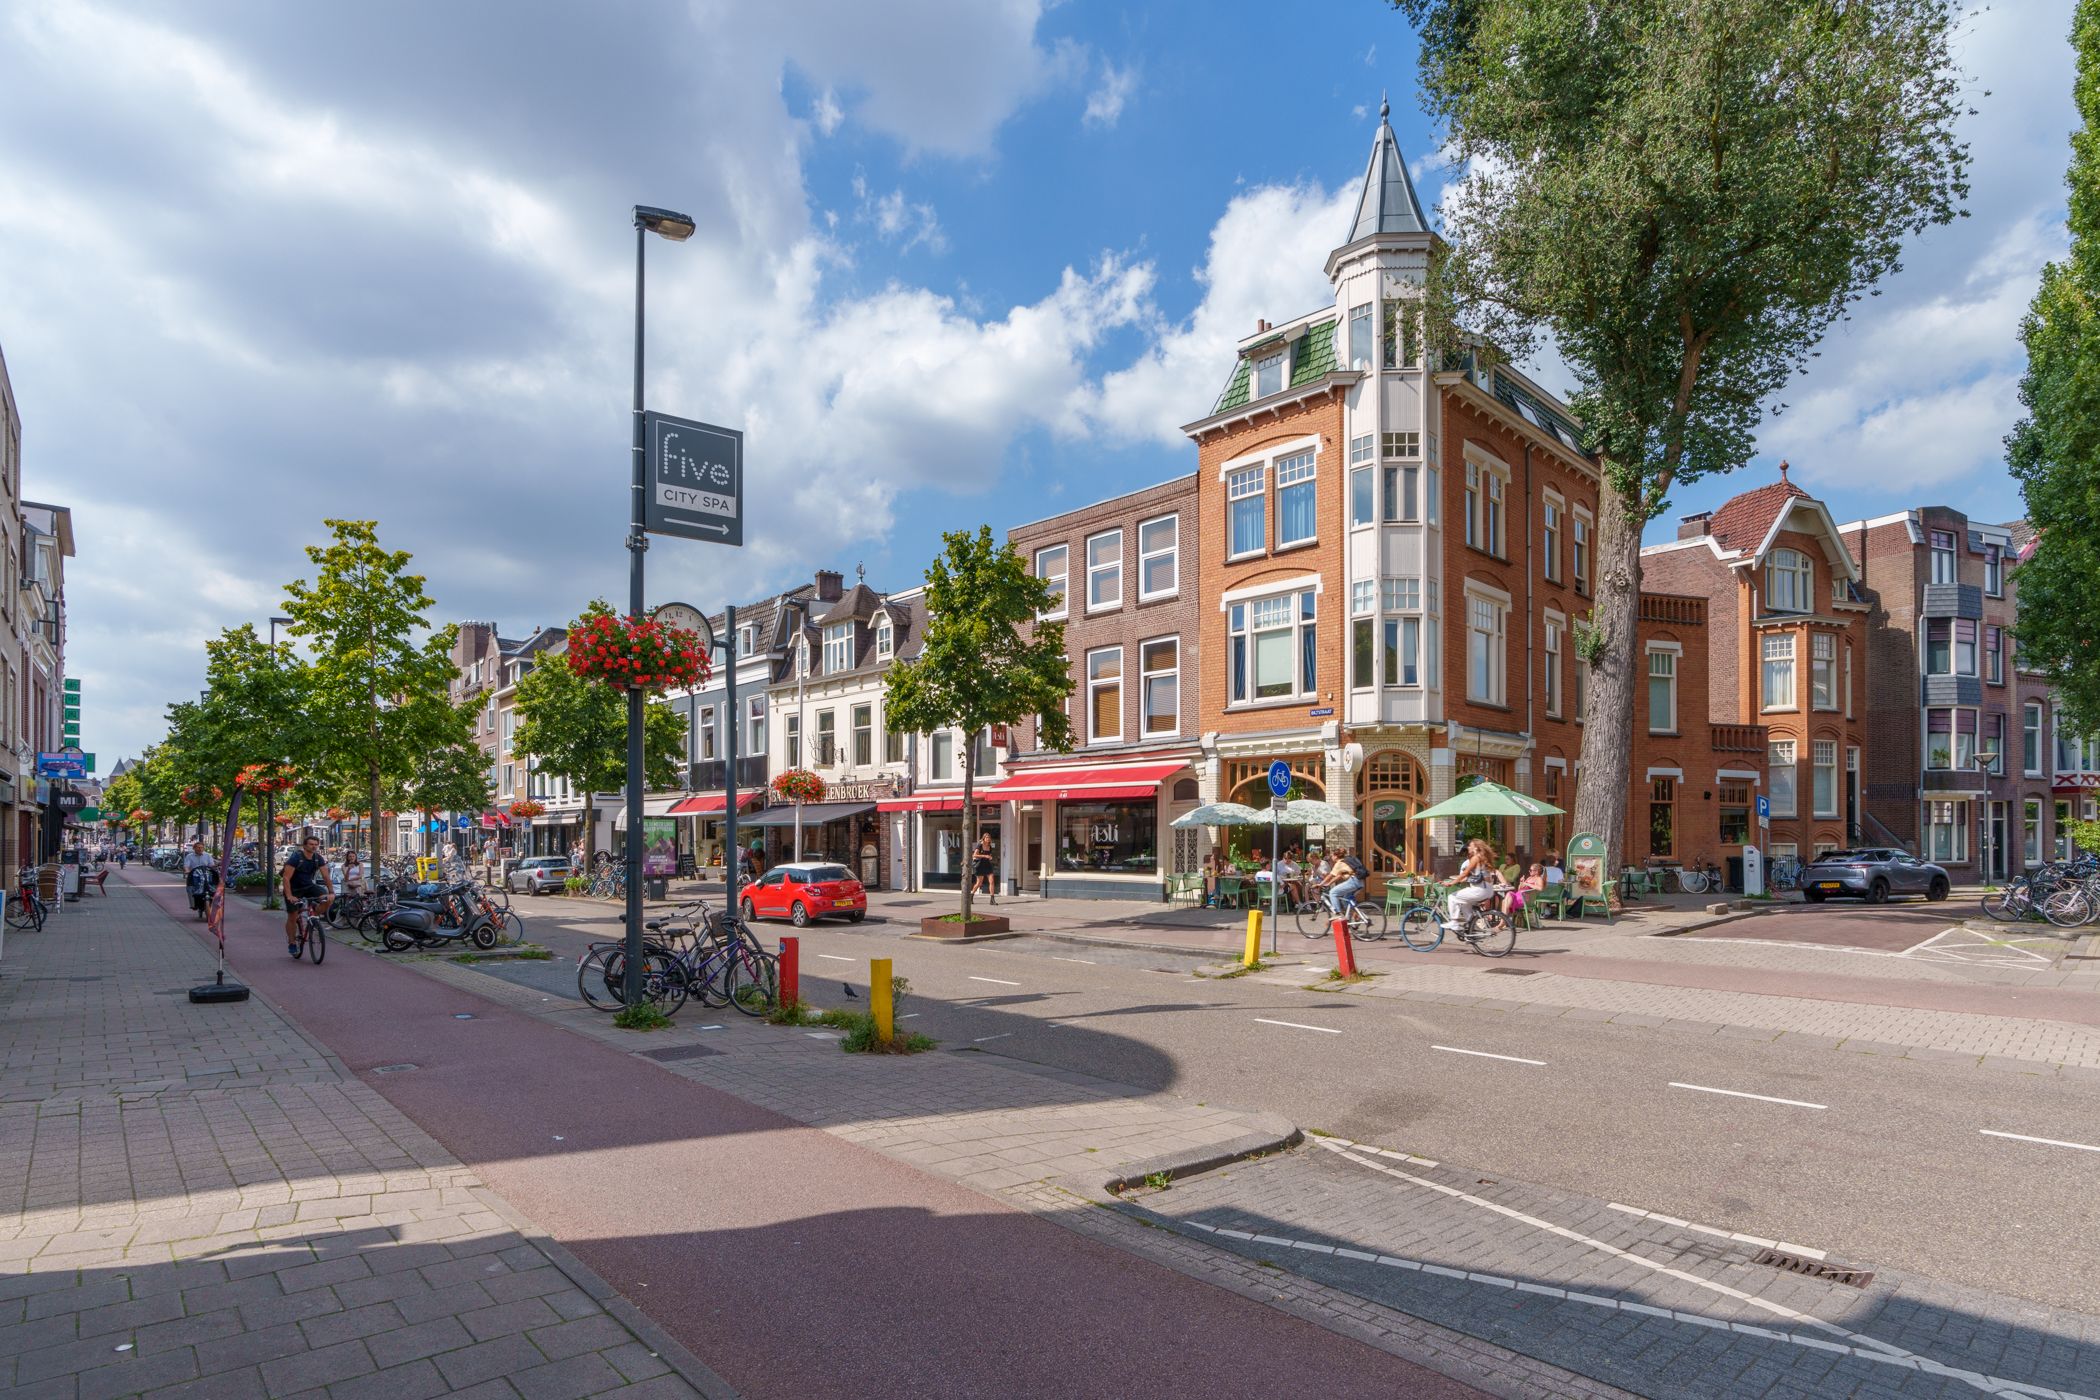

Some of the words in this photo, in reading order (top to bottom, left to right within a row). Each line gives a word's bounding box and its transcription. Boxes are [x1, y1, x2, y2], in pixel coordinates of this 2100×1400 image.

[663, 489, 699, 504] CITY
[702, 496, 730, 511] SPA
[826, 784, 870, 800] LENBROEK
[1760, 798, 1767, 814] P
[1089, 823, 1119, 842] Asli
